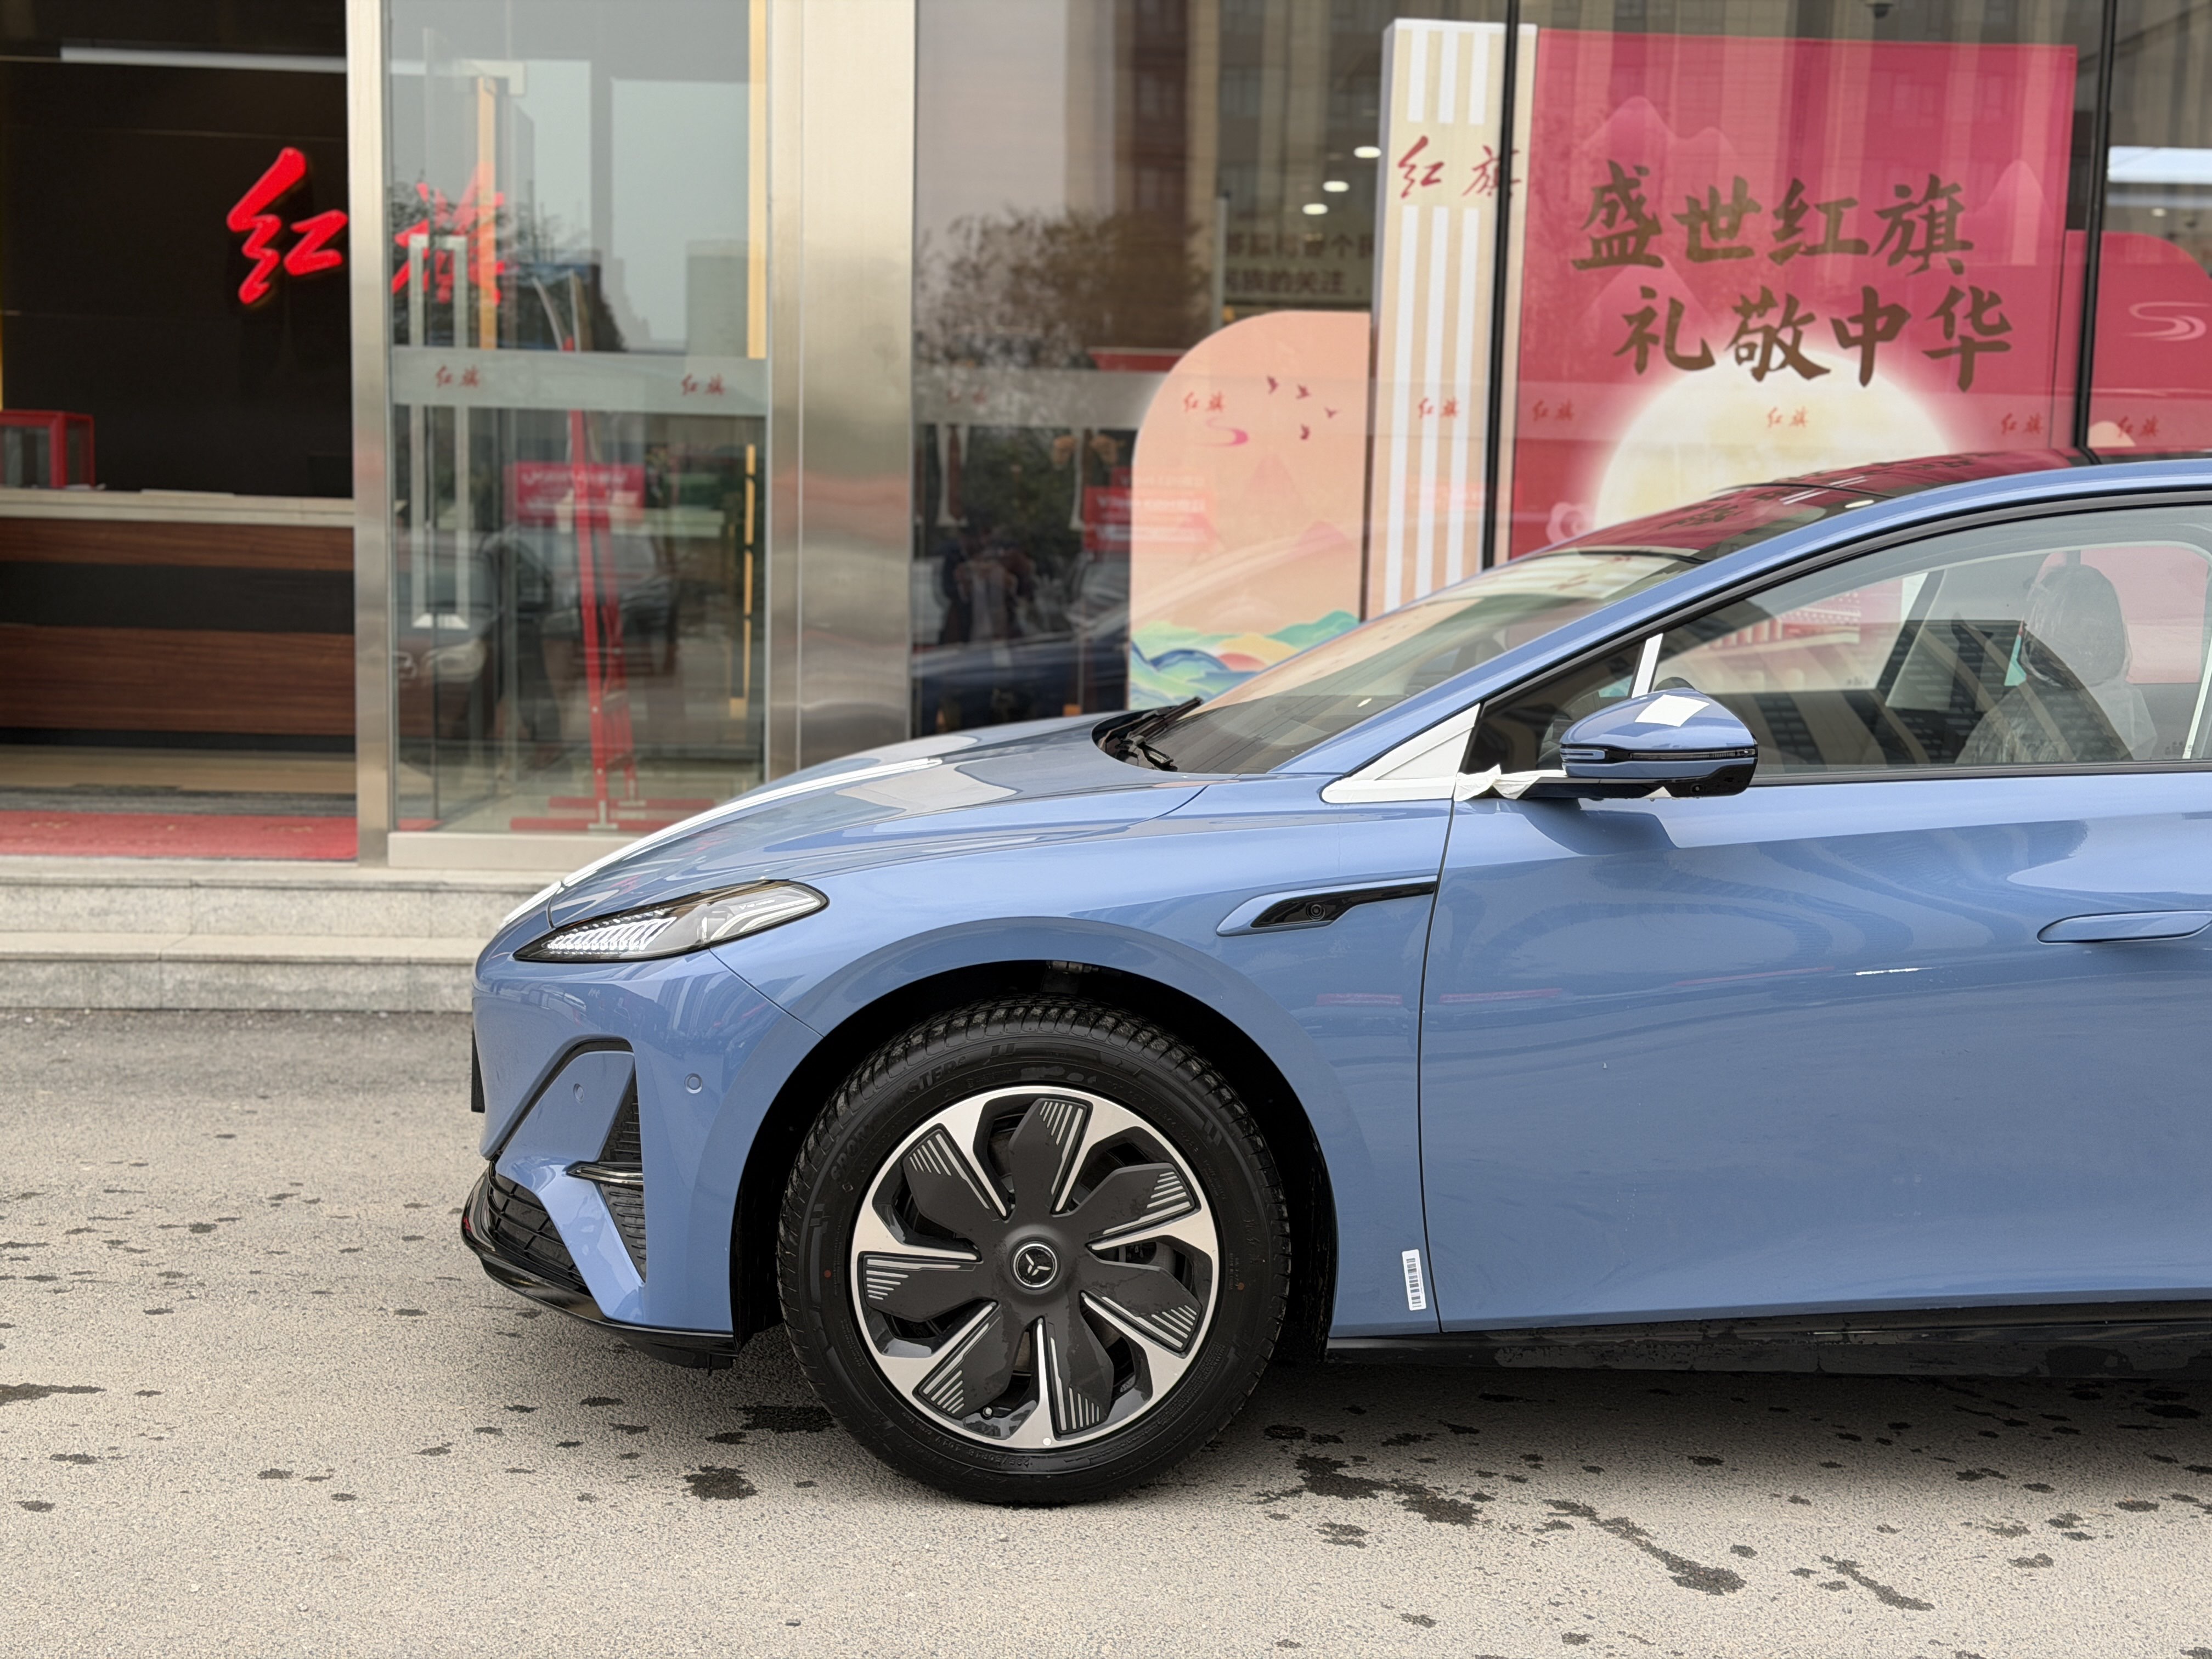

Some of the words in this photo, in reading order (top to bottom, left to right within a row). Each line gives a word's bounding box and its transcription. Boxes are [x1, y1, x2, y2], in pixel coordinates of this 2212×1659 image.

[1571, 159, 1974, 276] 盛世红旗
[1613, 285, 2014, 393] 礼敬中华
[436, 365, 480, 387] 红旗
[681, 374, 725, 395] 红旗
[1184, 392, 1224, 411] 红旗
[1419, 398, 1457, 417] 红旗
[1532, 400, 1575, 421] 红旗
[1767, 406, 1808, 428] 红旗
[2000, 413, 2042, 435] 红旗
[2117, 415, 2159, 438] 红旗
